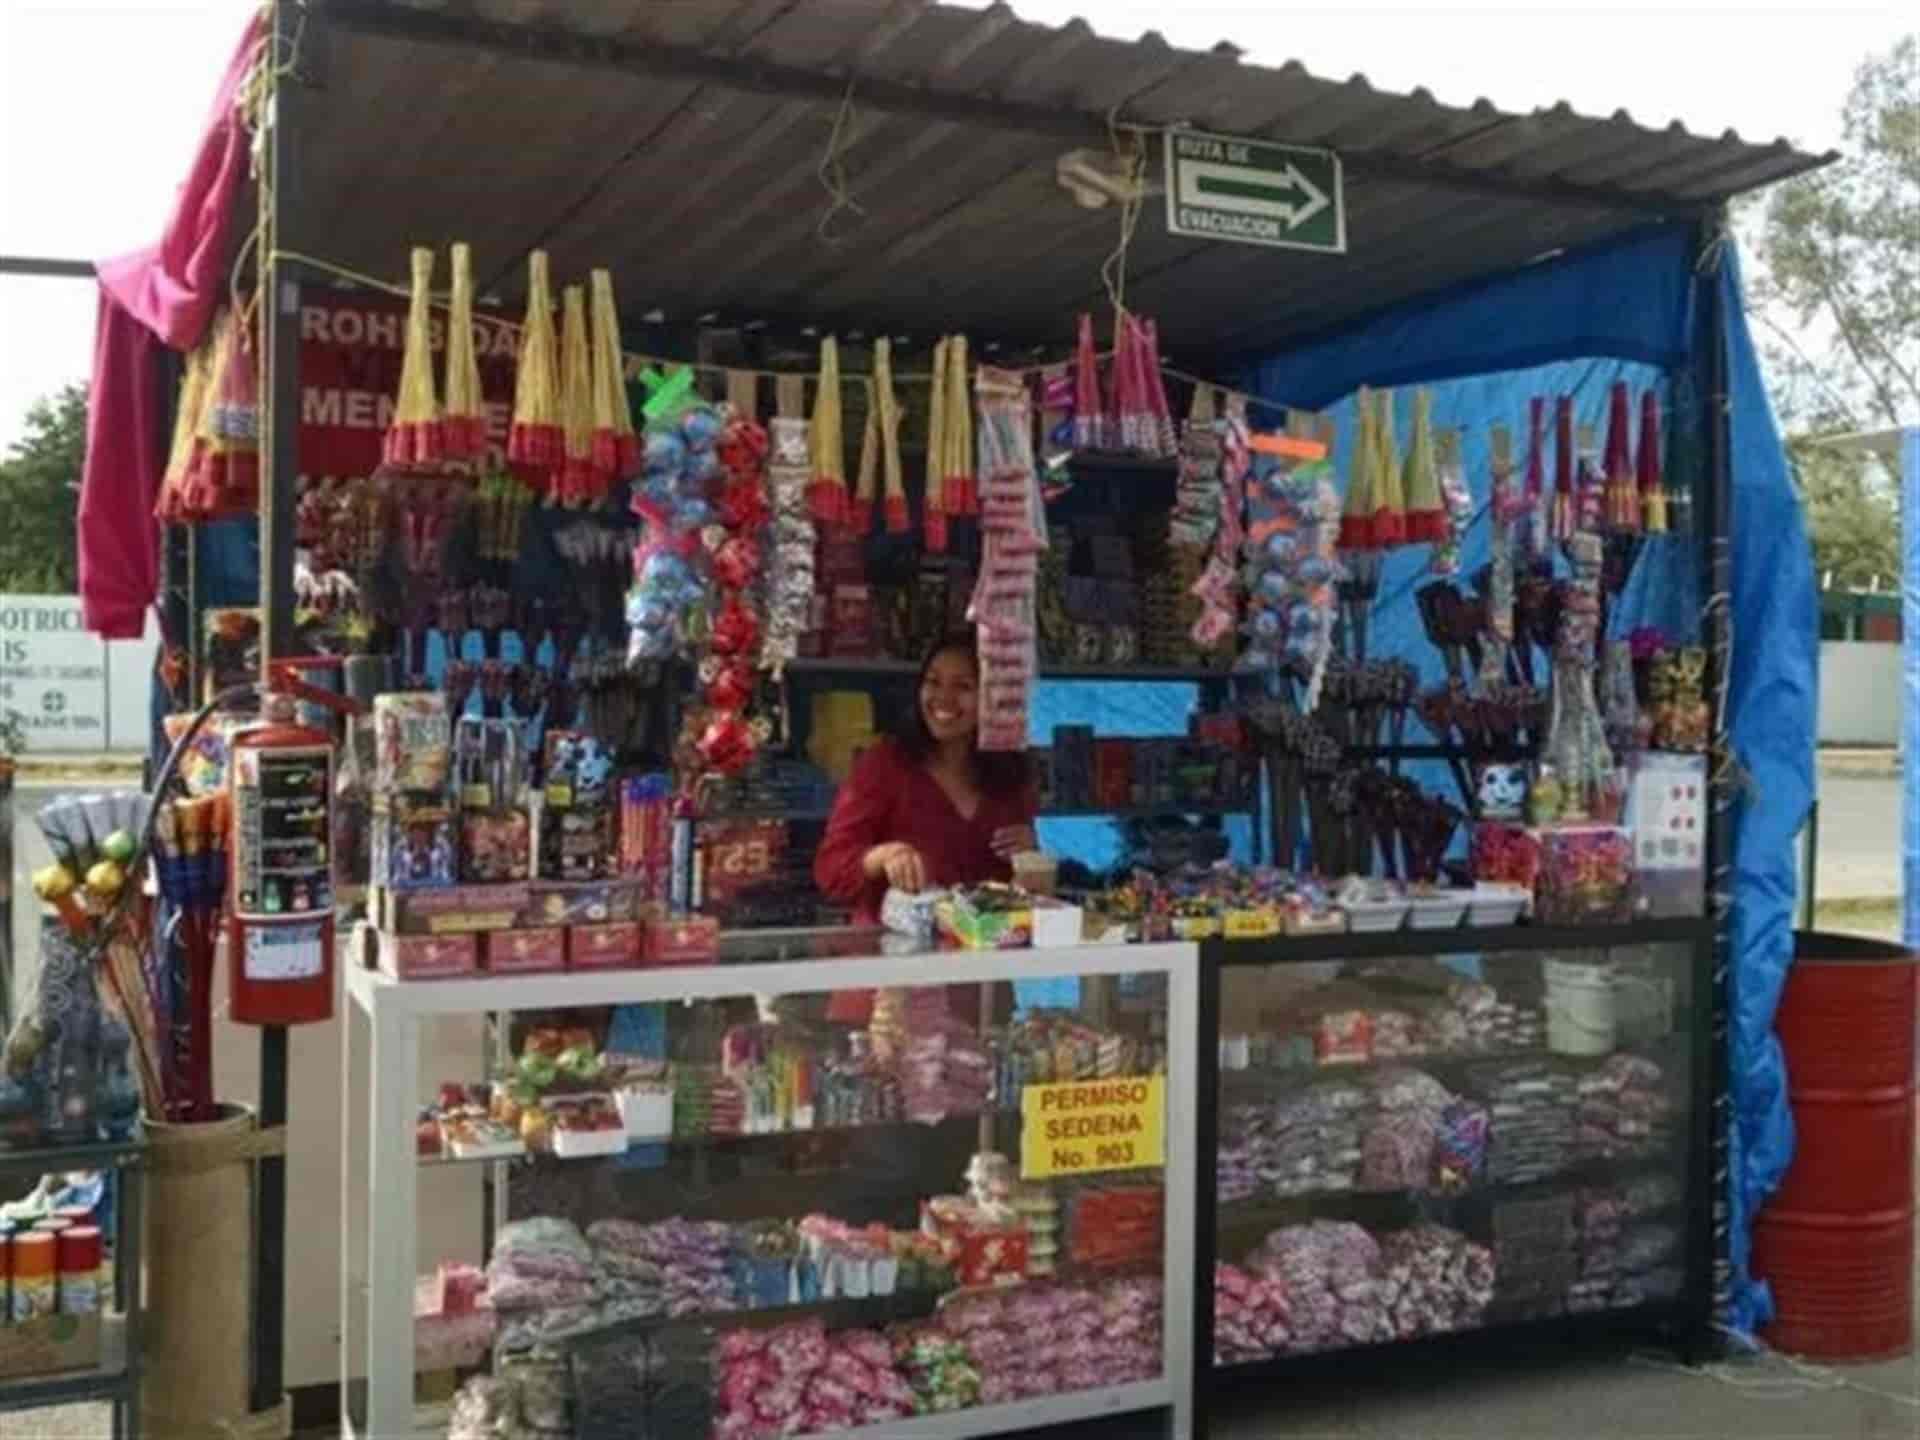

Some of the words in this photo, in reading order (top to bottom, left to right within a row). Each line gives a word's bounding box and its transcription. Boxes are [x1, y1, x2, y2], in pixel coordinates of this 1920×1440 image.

[1178, 135, 1224, 158] RUTA
[1227, 143, 1249, 163] DE
[1040, 1083, 1148, 1112] PERMISO
[1046, 1113, 1143, 1140] SEDENA
